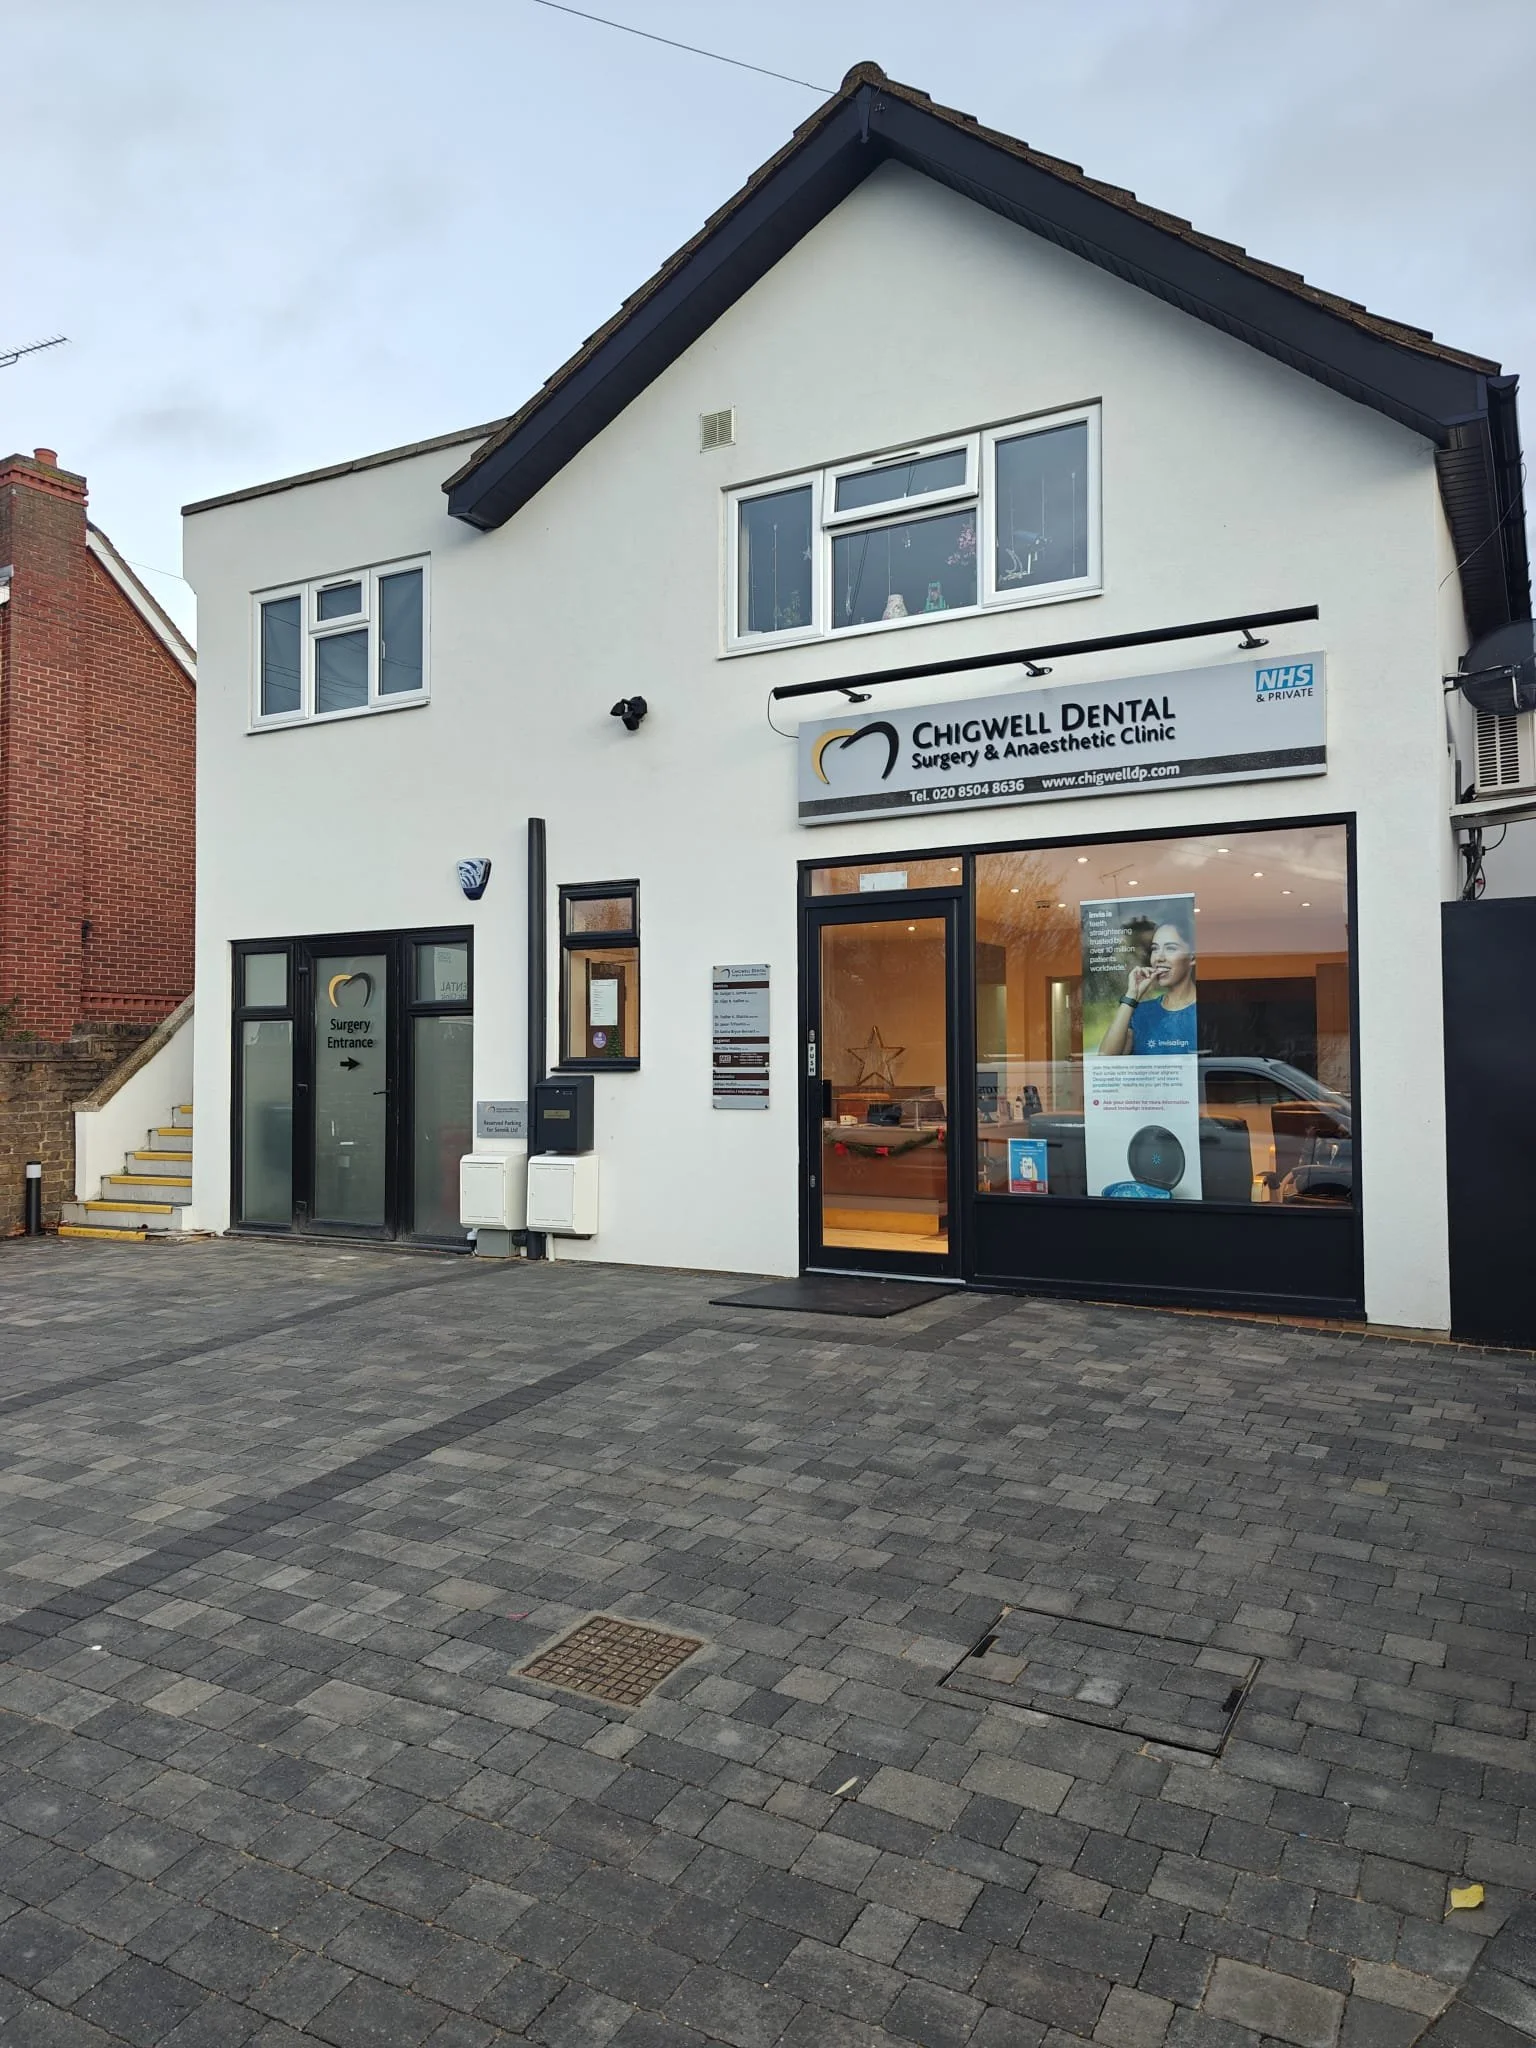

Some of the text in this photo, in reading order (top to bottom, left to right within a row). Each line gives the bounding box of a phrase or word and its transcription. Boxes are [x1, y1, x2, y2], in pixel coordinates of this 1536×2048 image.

[1257, 665, 1312, 691] NHS
[1256, 688, 1313, 703] & PRIVATE
[912, 696, 1176, 749] CHIGWELL DENTAL
[911, 723, 1176, 771] Surgery & Anaesthetic Clinic
[910, 765, 1180, 803] Tel. 020 8504 8636 www.chigwelldp.com
[1090, 928, 1132, 937] straightening
[1113, 937, 1123, 945] by
[1114, 945, 1135, 953] million
[330, 1018, 371, 1034] Surgery
[327, 1036, 374, 1049] Entrance
[1158, 1039, 1189, 1048] invisalign
[505, 1119, 521, 1127] Parking
